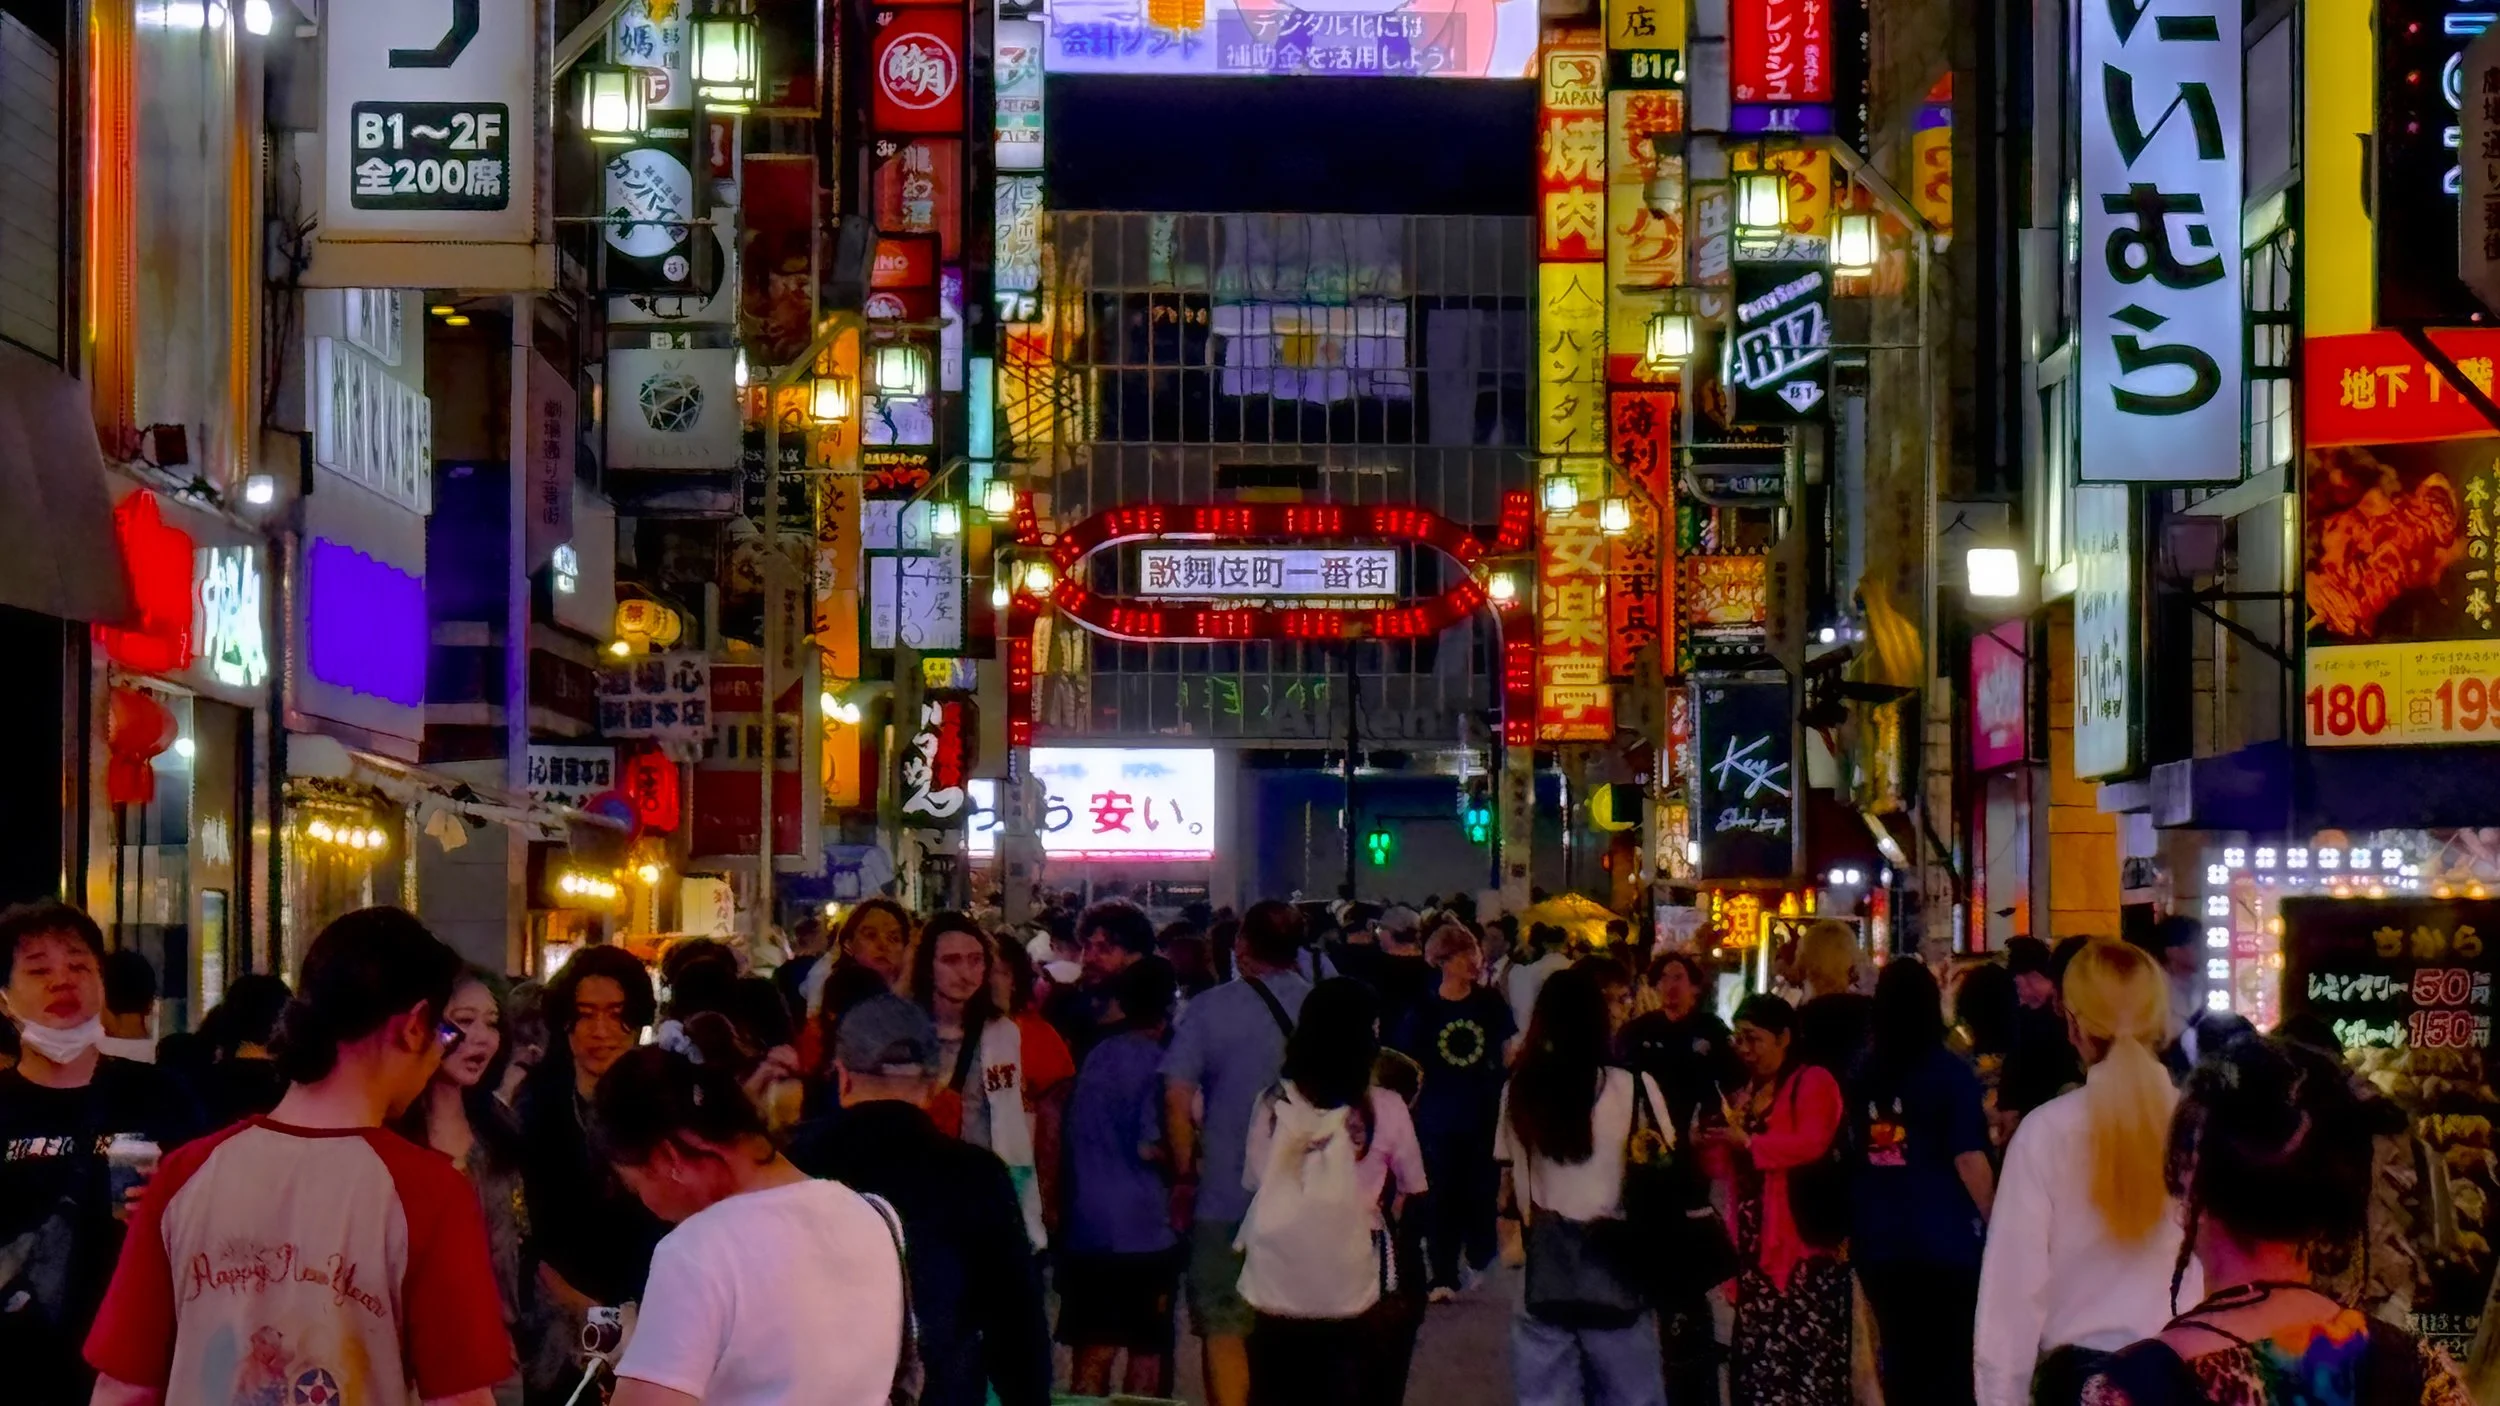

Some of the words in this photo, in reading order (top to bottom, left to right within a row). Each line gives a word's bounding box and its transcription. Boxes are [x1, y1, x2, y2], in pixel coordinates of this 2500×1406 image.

[1253, 13, 1424, 40] デジタル化には
[1624, 5, 1656, 38] 店
[1060, 25, 1202, 58] 会計ソフト
[356, 156, 502, 196] 全200席
[1543, 117, 1605, 250] 焼肉
[996, 291, 1038, 321] 7F
[649, 332, 692, 350] B1
[1148, 555, 1389, 588] 歌舞伎町一番街
[1543, 511, 1610, 719] 安楽亭
[2307, 682, 2386, 736] 180
[1709, 734, 1792, 800] Key
